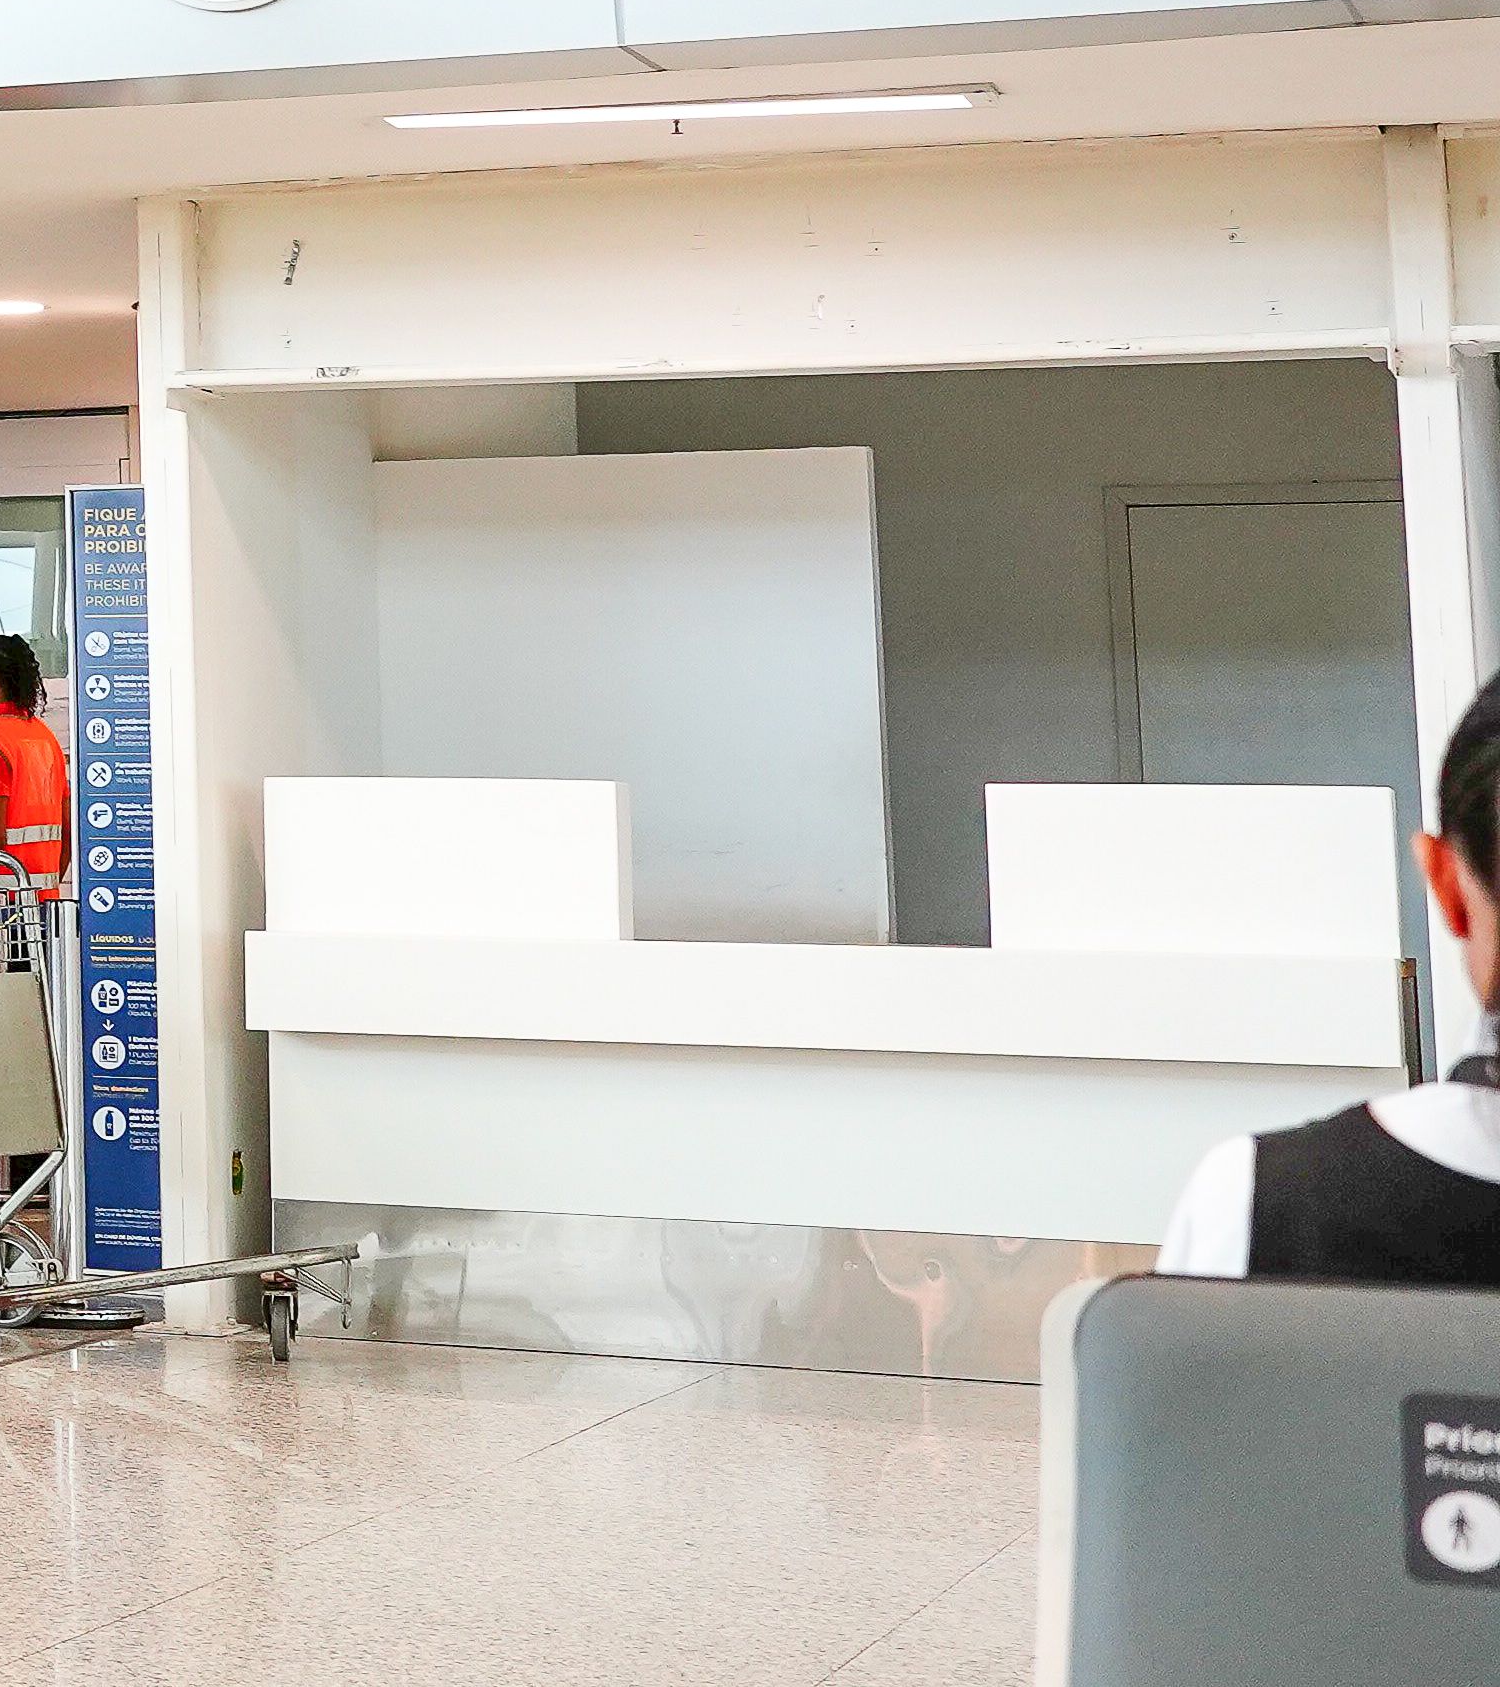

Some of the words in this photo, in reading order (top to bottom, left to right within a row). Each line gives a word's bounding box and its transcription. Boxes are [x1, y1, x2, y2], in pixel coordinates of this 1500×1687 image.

[84, 508, 137, 522] FIQUE
[84, 524, 132, 538] PARA
[84, 563, 104, 575] BE
[85, 579, 131, 591] THESE
